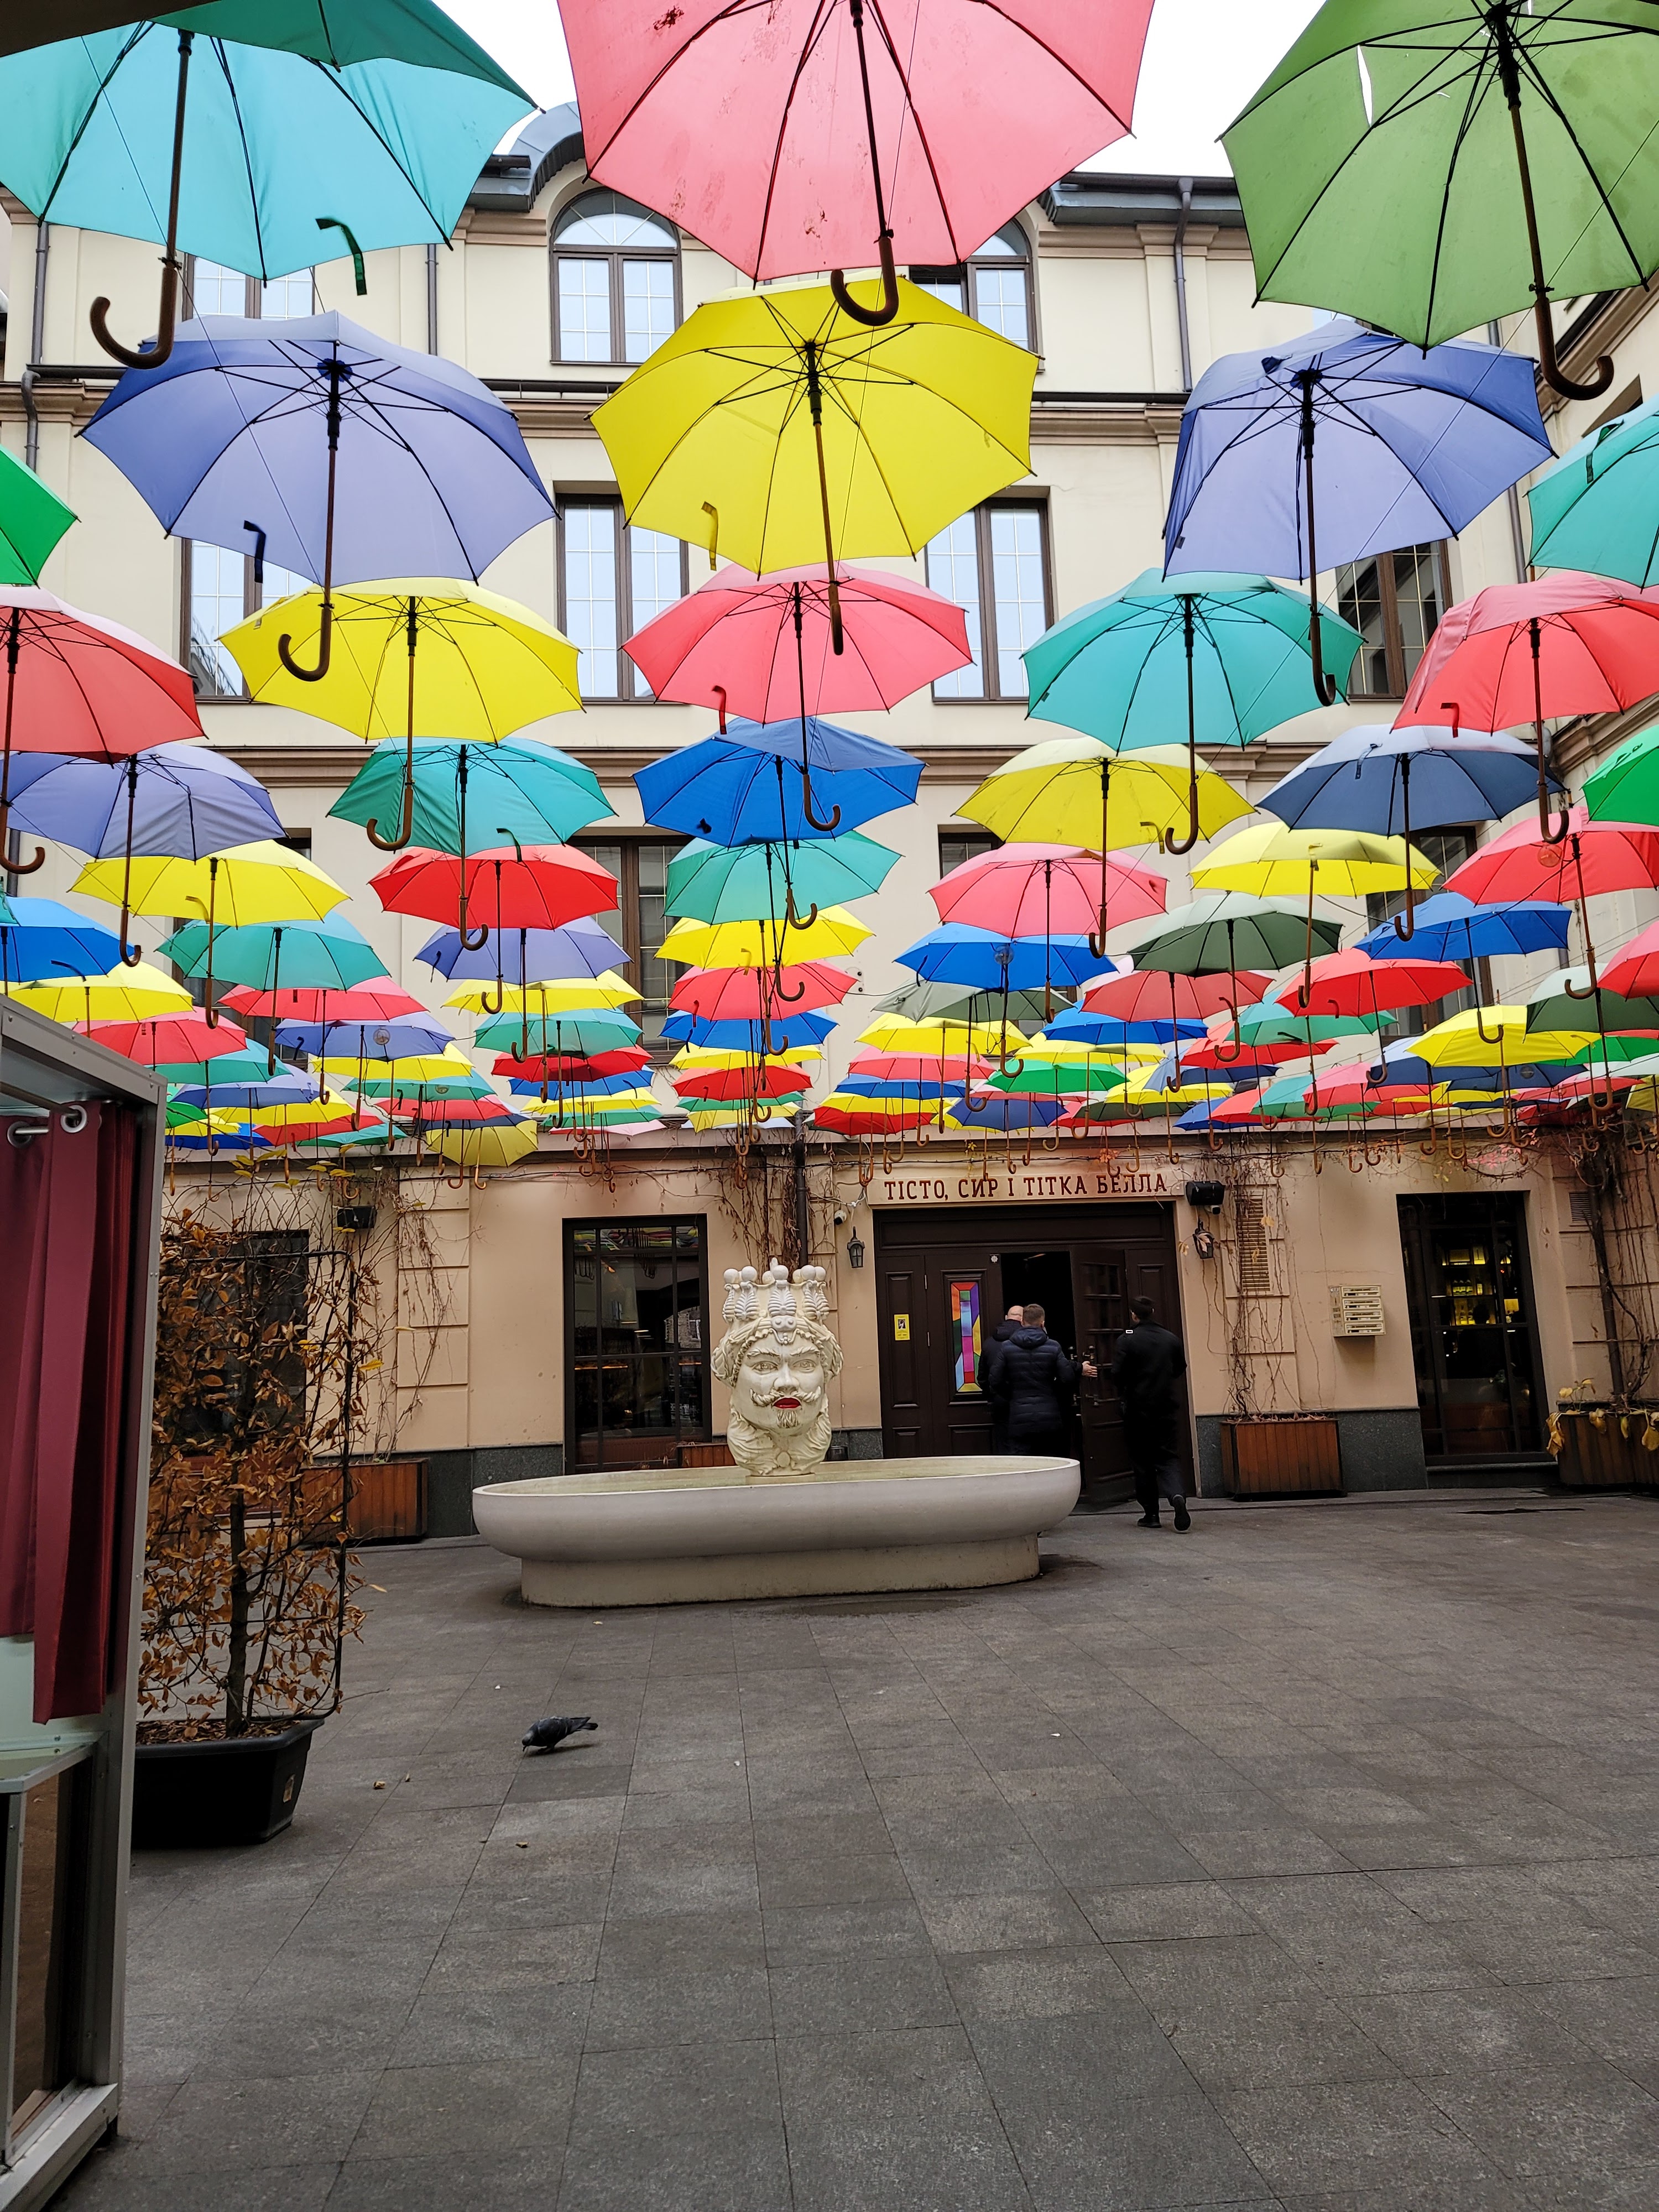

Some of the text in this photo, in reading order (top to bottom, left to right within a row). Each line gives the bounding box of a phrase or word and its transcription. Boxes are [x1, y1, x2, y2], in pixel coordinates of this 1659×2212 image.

[884, 1173, 1167, 1201] ТІСТО, СИР І ТІТКА БЕЛЛА
